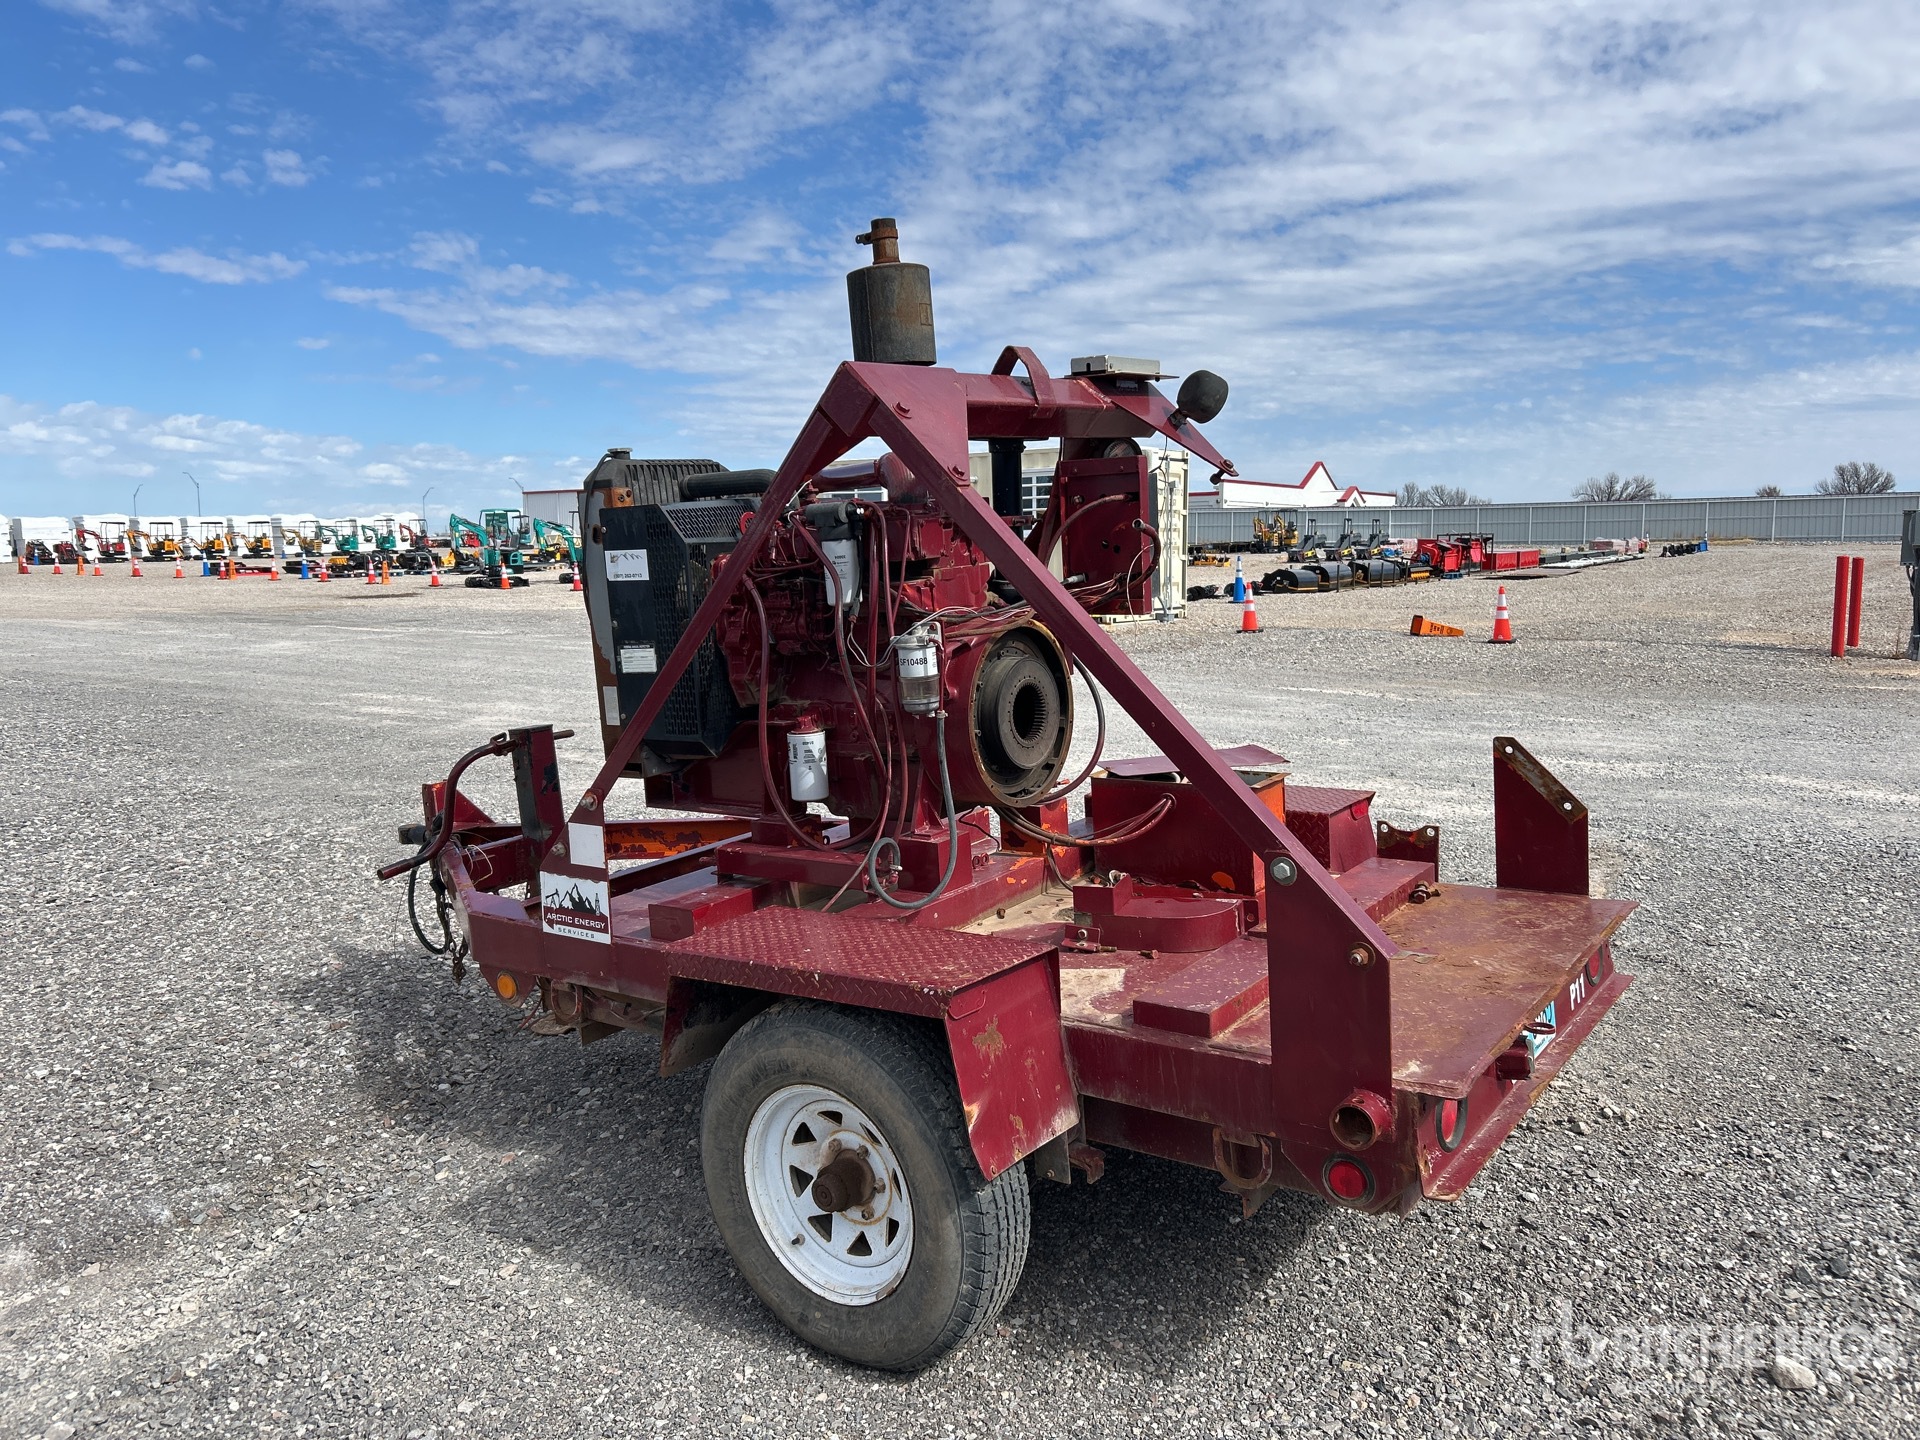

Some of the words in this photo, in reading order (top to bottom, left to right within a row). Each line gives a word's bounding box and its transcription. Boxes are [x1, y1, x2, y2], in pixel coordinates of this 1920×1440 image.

[900, 657, 928, 666] SF10488
[546, 912, 573, 923] ARCTIC
[574, 917, 606, 929] ENERGY
[557, 927, 595, 939] SERVICES
[1569, 972, 1586, 1011] P11
